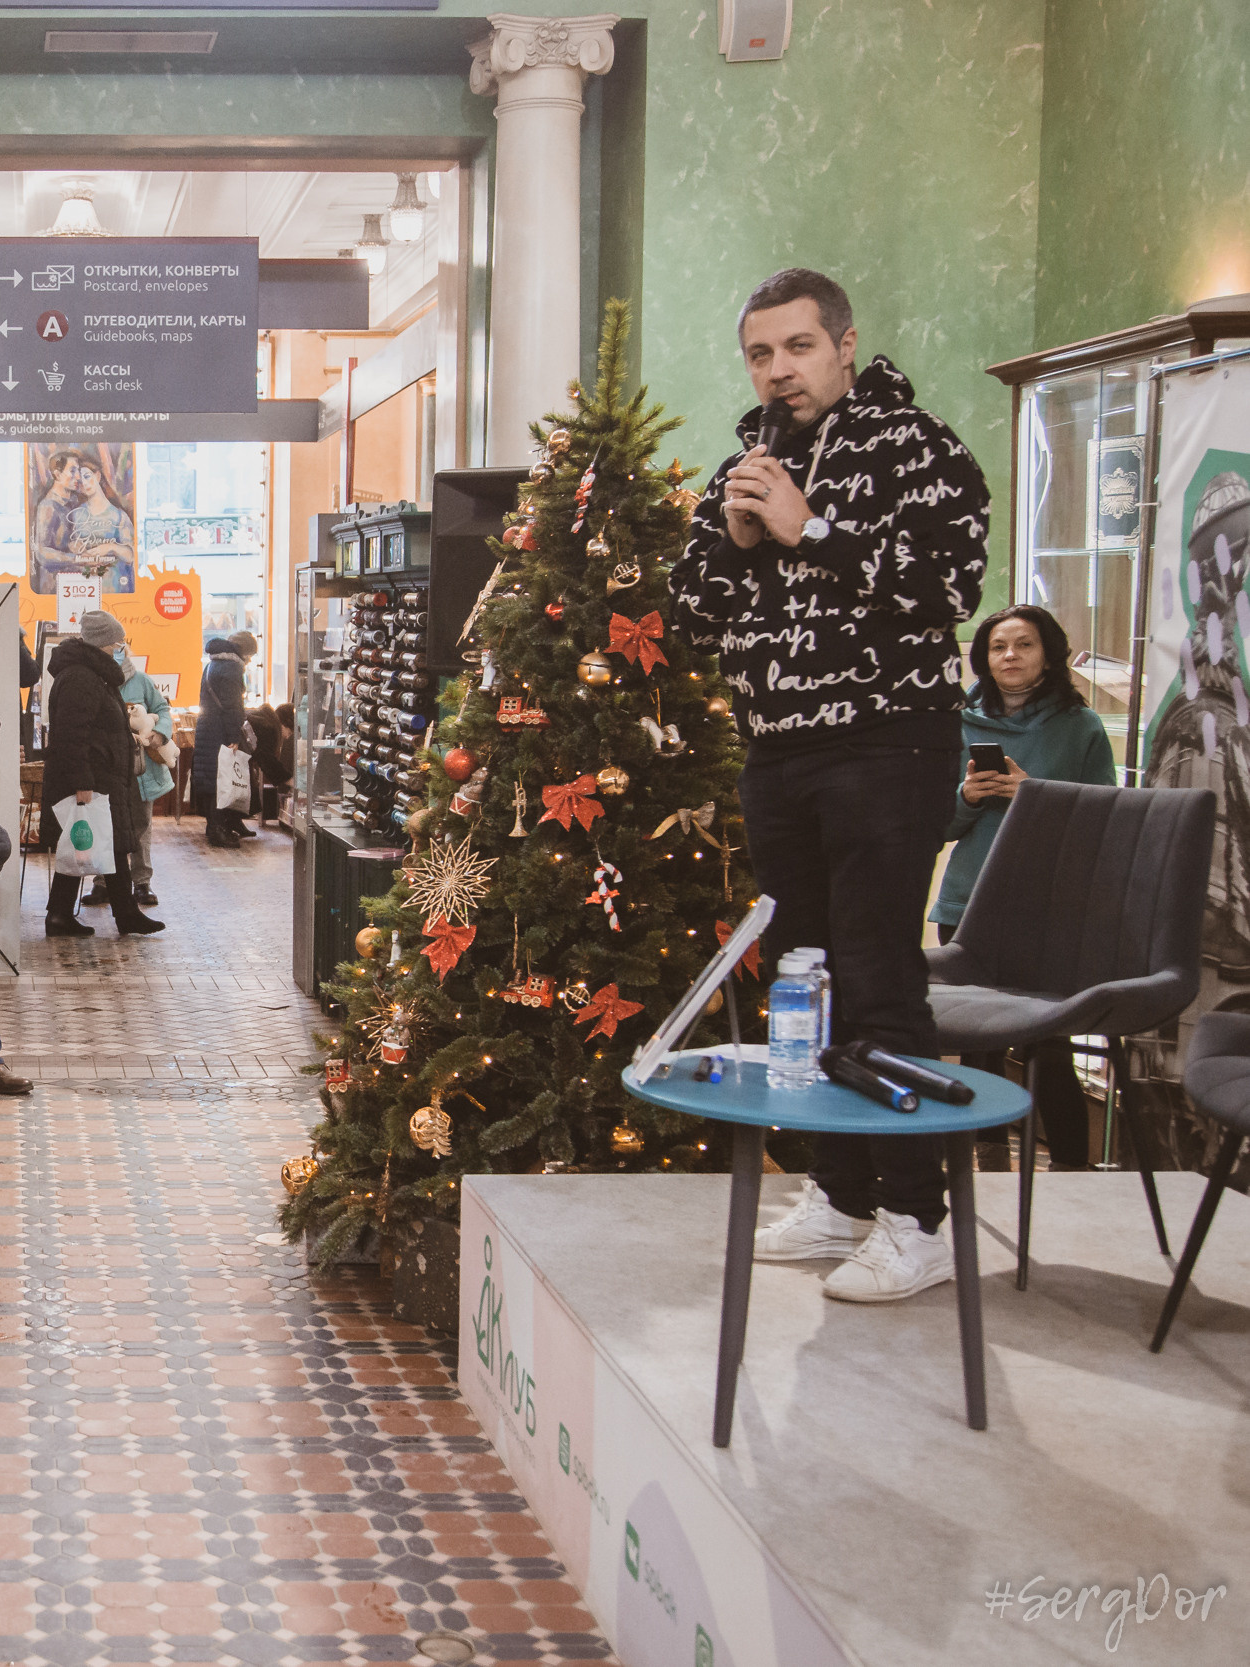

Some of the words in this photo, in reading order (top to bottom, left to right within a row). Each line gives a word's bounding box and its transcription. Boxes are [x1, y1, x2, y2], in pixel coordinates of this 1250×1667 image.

[84, 265, 162, 279] ОТКРЫТКИ,
[165, 265, 239, 277] КОНВЕРТЫ
[84, 280, 142, 293] Postcard,
[145, 280, 209, 293] envelopes
[84, 315, 197, 329] ПУТЕВОДИТЕЛИ,
[200, 315, 246, 327] КАРТЫ
[84, 330, 158, 343] Guidebooks,
[161, 332, 193, 343] maps
[84, 365, 131, 377] КАССЫ
[84, 380, 113, 391] Cash
[116, 380, 143, 391] desk
[10, 423, 74, 436] guidebooks,
[76, 425, 103, 436] maps
